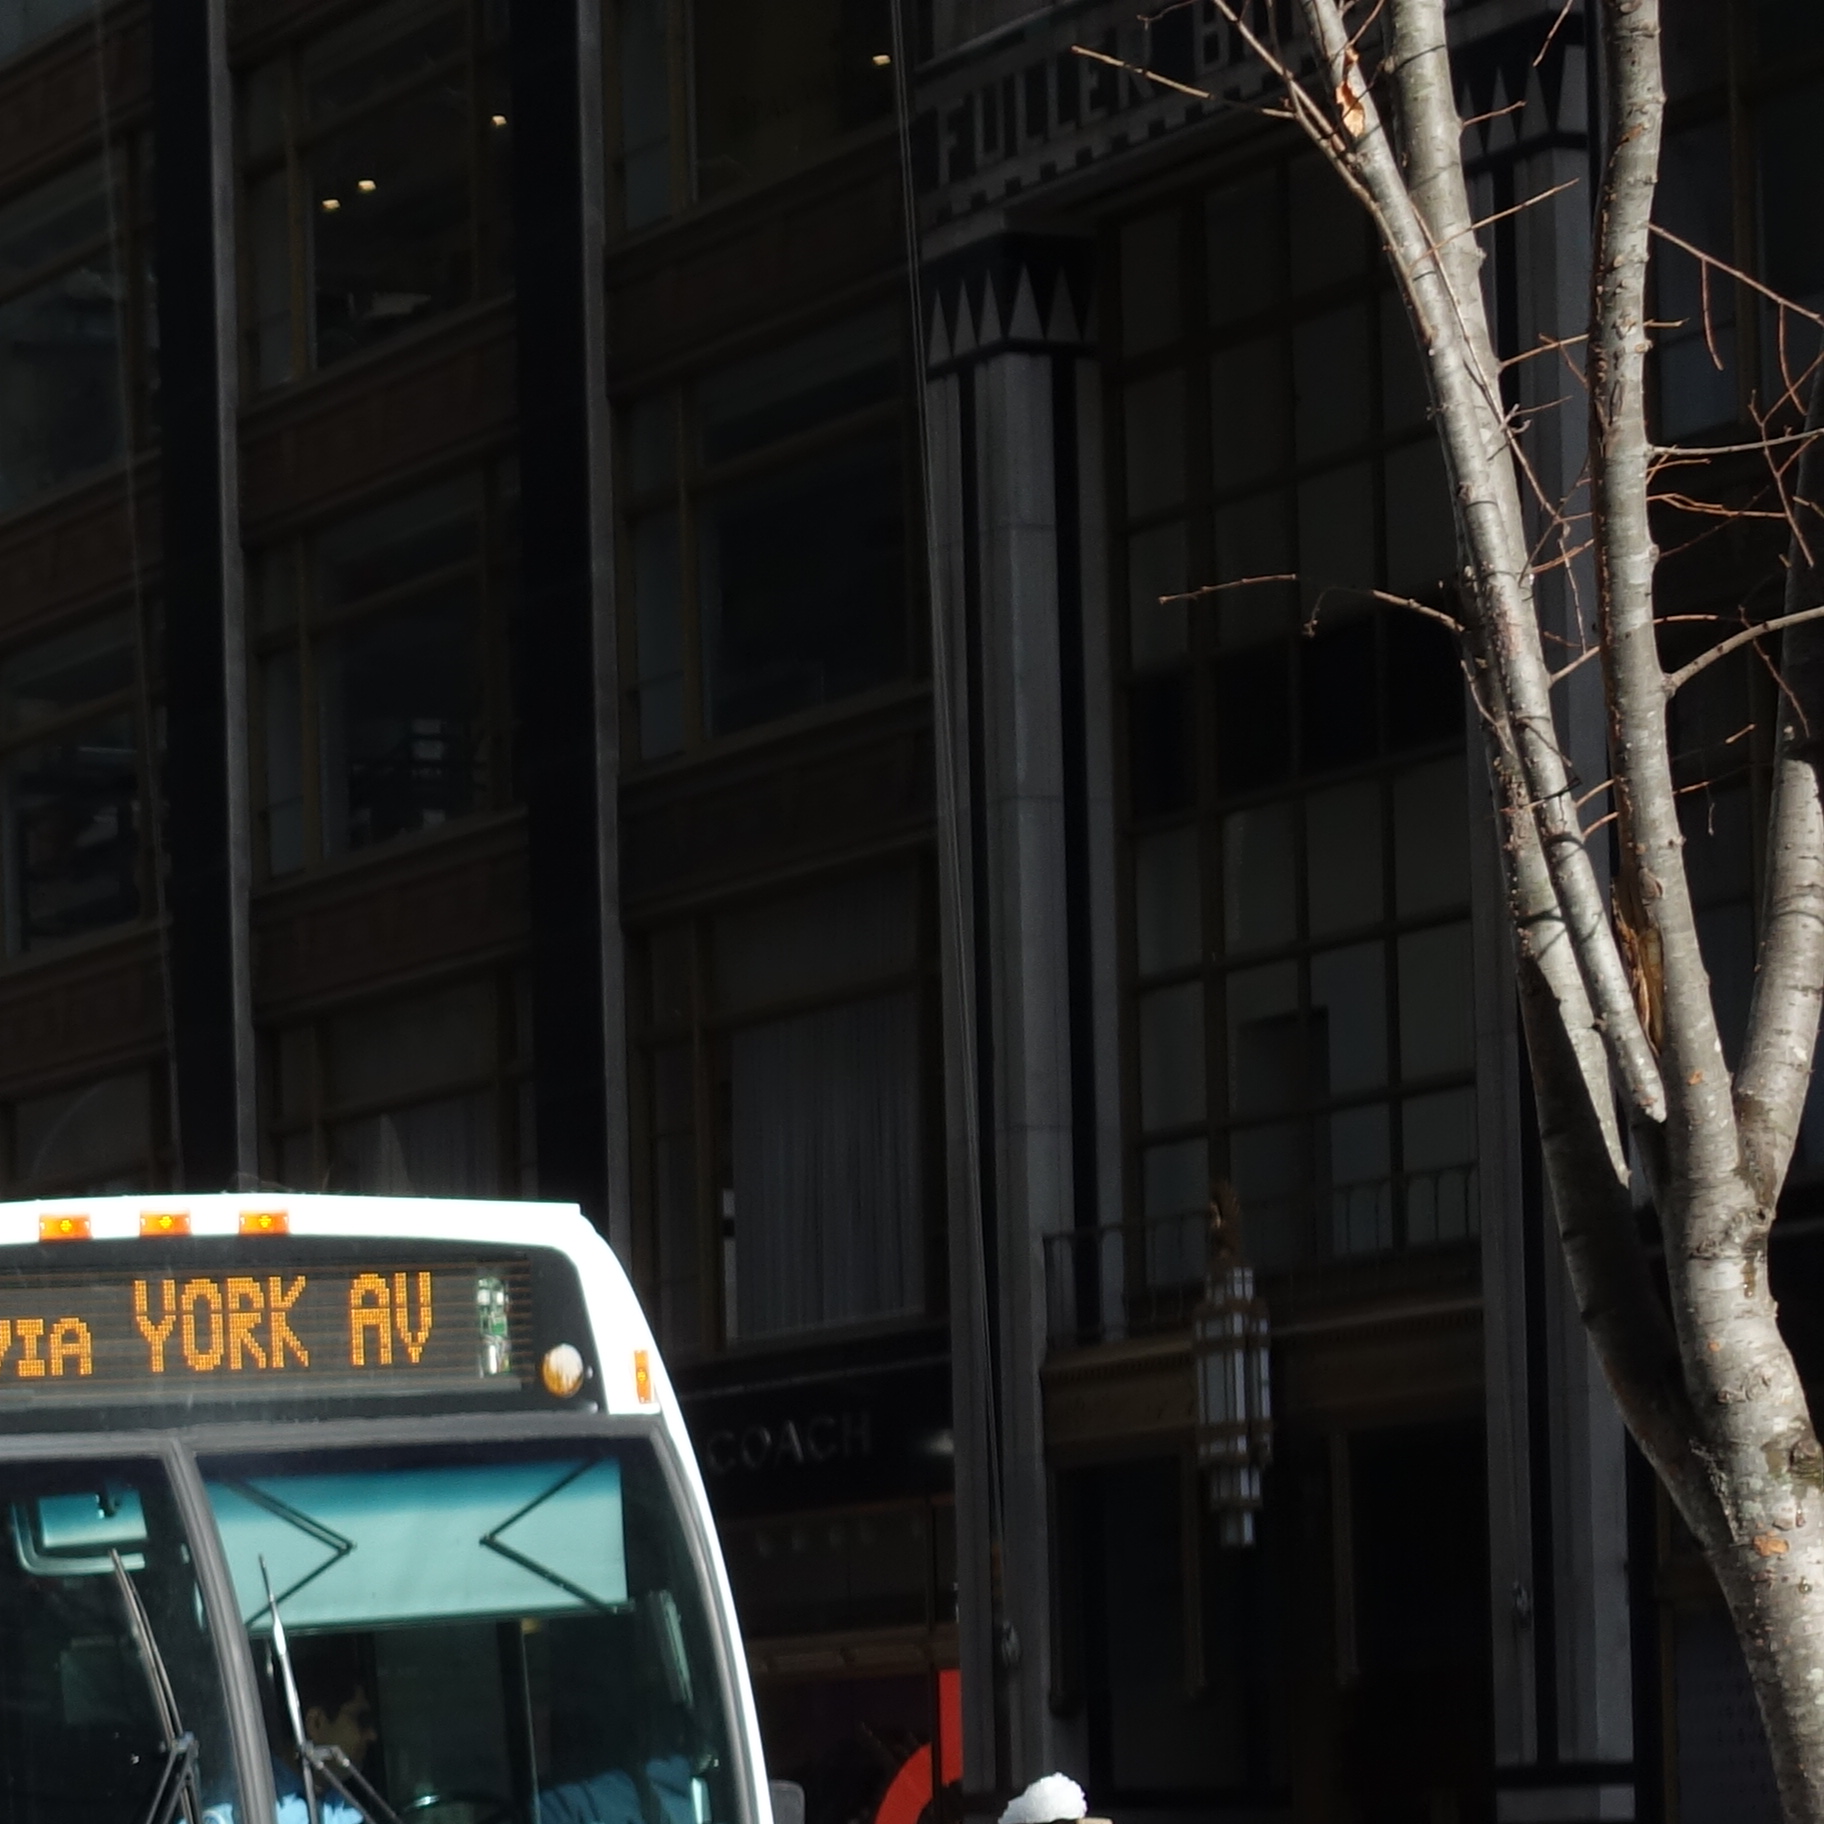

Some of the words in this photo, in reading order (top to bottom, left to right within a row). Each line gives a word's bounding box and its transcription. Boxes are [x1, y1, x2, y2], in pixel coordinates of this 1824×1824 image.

[936, 26, 1155, 194] FULLER
[133, 1274, 310, 1374] YORK
[351, 1271, 433, 1366] AV
[705, 1409, 872, 1476] COACH
